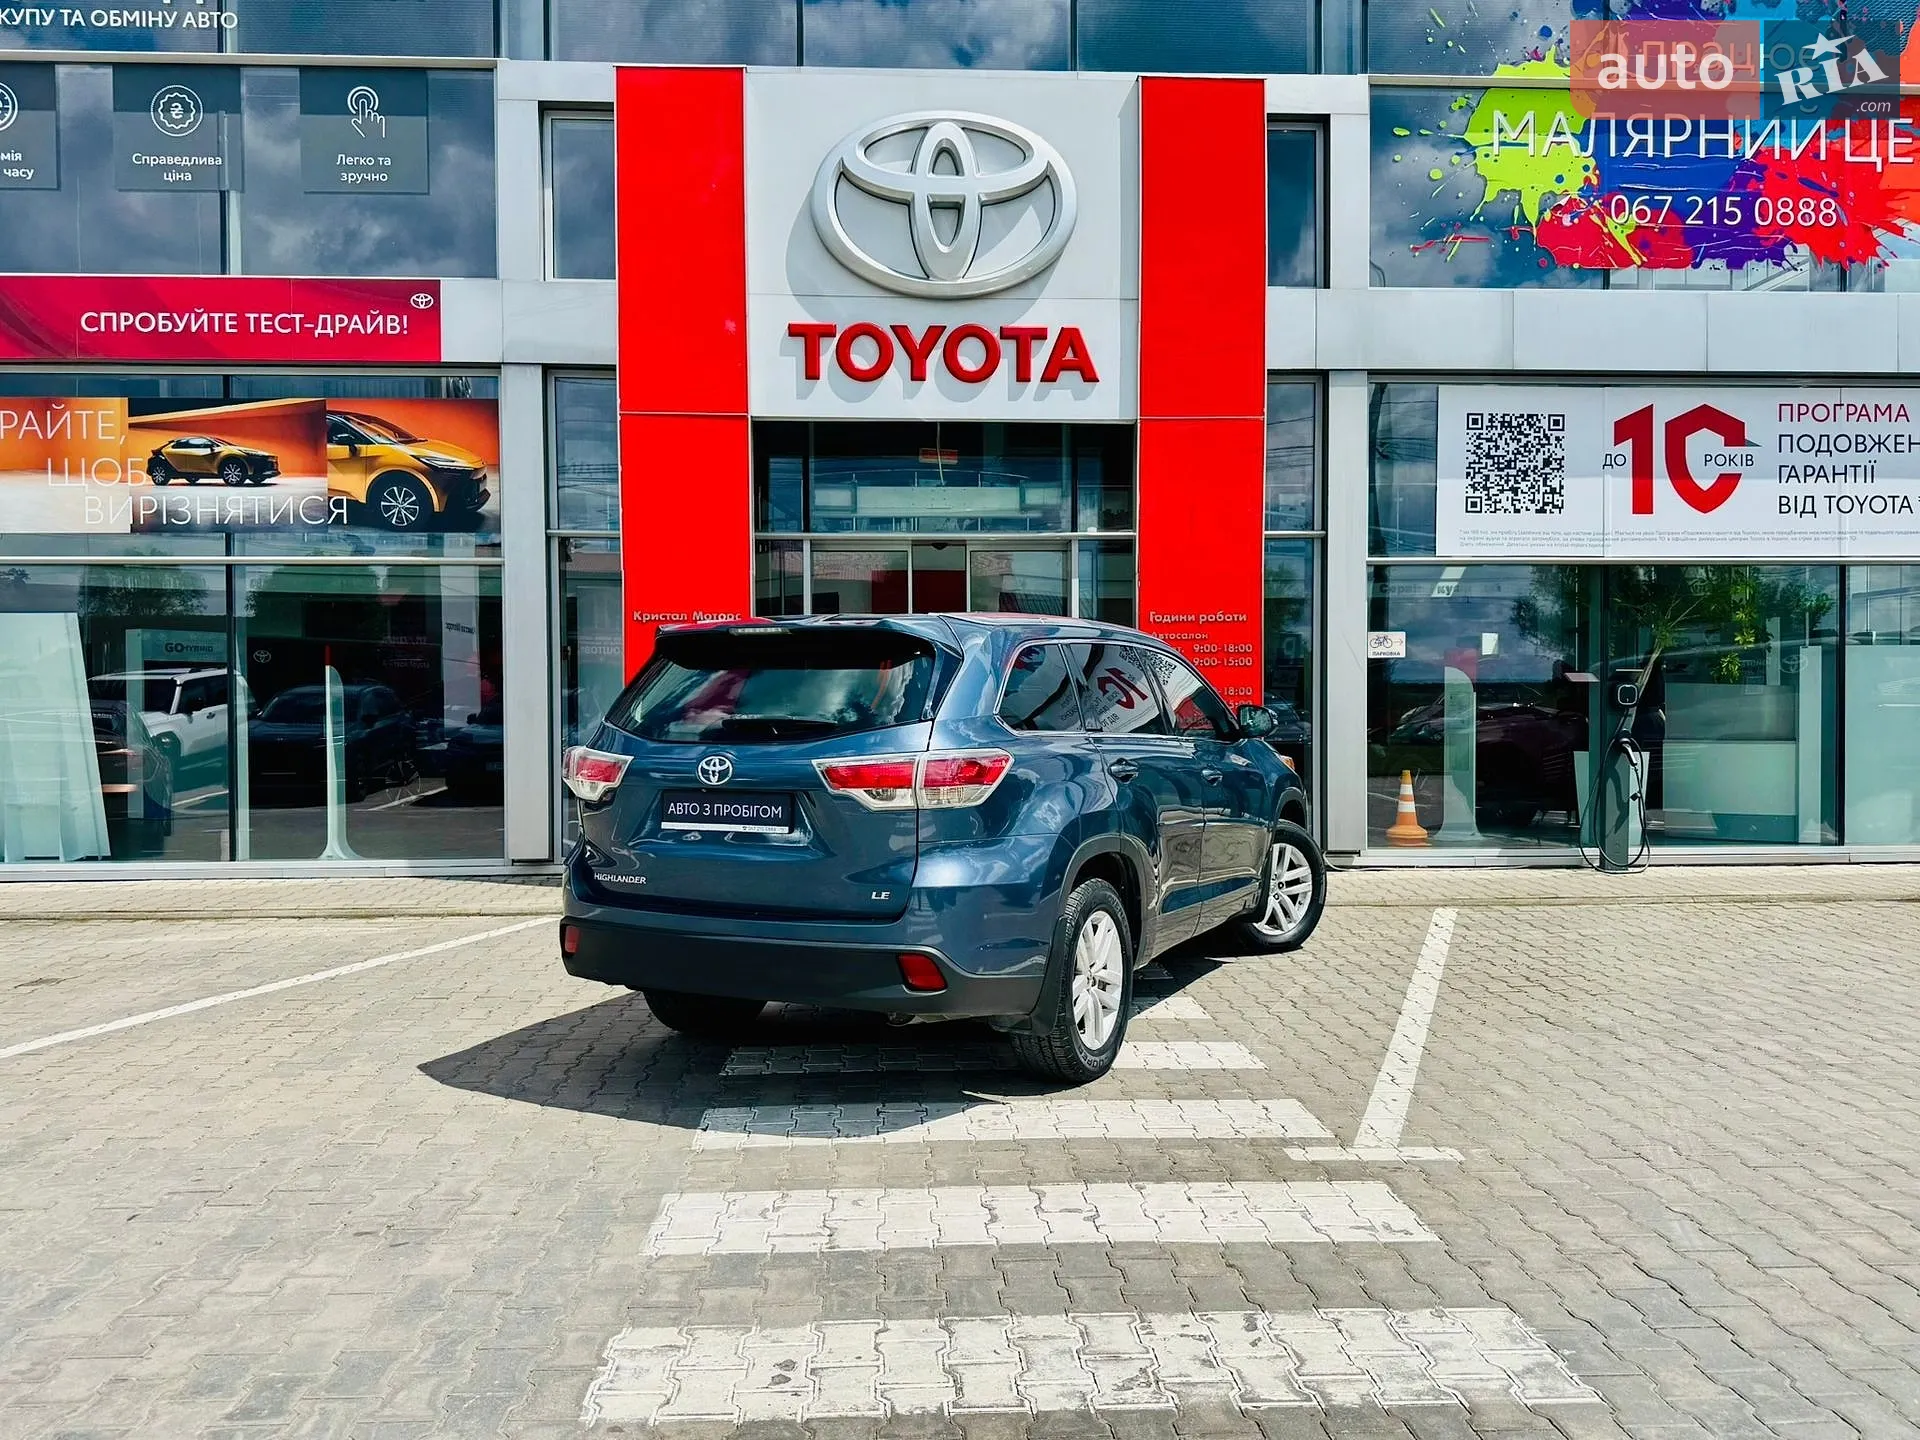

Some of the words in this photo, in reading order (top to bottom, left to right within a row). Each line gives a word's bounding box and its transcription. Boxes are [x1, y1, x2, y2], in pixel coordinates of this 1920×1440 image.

[60, 9, 85, 26] ТА
[90, 9, 178, 28] ОБМІНУ
[182, 11, 238, 28] АВТО
[1845, 117, 1914, 173] ЦЕ
[132, 153, 223, 167] Справедлива
[336, 153, 374, 168] Легко
[378, 156, 392, 167] та
[3, 168, 34, 180] часу
[164, 166, 192, 182] ціна
[340, 170, 389, 184] зручно
[1611, 194, 1673, 226] 067
[1684, 195, 1742, 226] 215
[1754, 196, 1838, 228] 0888
[80, 308, 238, 335] СПРОБУЙТЕ
[245, 310, 409, 337] ТЕСТ-ДРАЙВ!
[788, 322, 1100, 383] TOYOTA
[1778, 403, 1910, 423] ПРОГРАМА
[1602, 453, 1627, 470] ДО
[1614, 403, 1746, 515] 10
[1704, 453, 1755, 468] РОКІВ
[47, 457, 148, 490] ЩОБ
[1778, 459, 1877, 484] ГАРАНТІЇ
[84, 495, 348, 525] ВИРІЗНЯТИСЯ
[1778, 495, 1817, 518] ВІД
[1823, 495, 1914, 514] TOYOTA
[633, 611, 688, 622] Кристал
[692, 611, 742, 621] Моторс
[1149, 611, 1196, 623] Години
[667, 802, 700, 815] АВТО
[702, 803, 711, 816] З
[713, 803, 782, 819] ПРОБІГОМ
[594, 872, 647, 885] HIGHLANDER
[871, 891, 891, 900] LE
